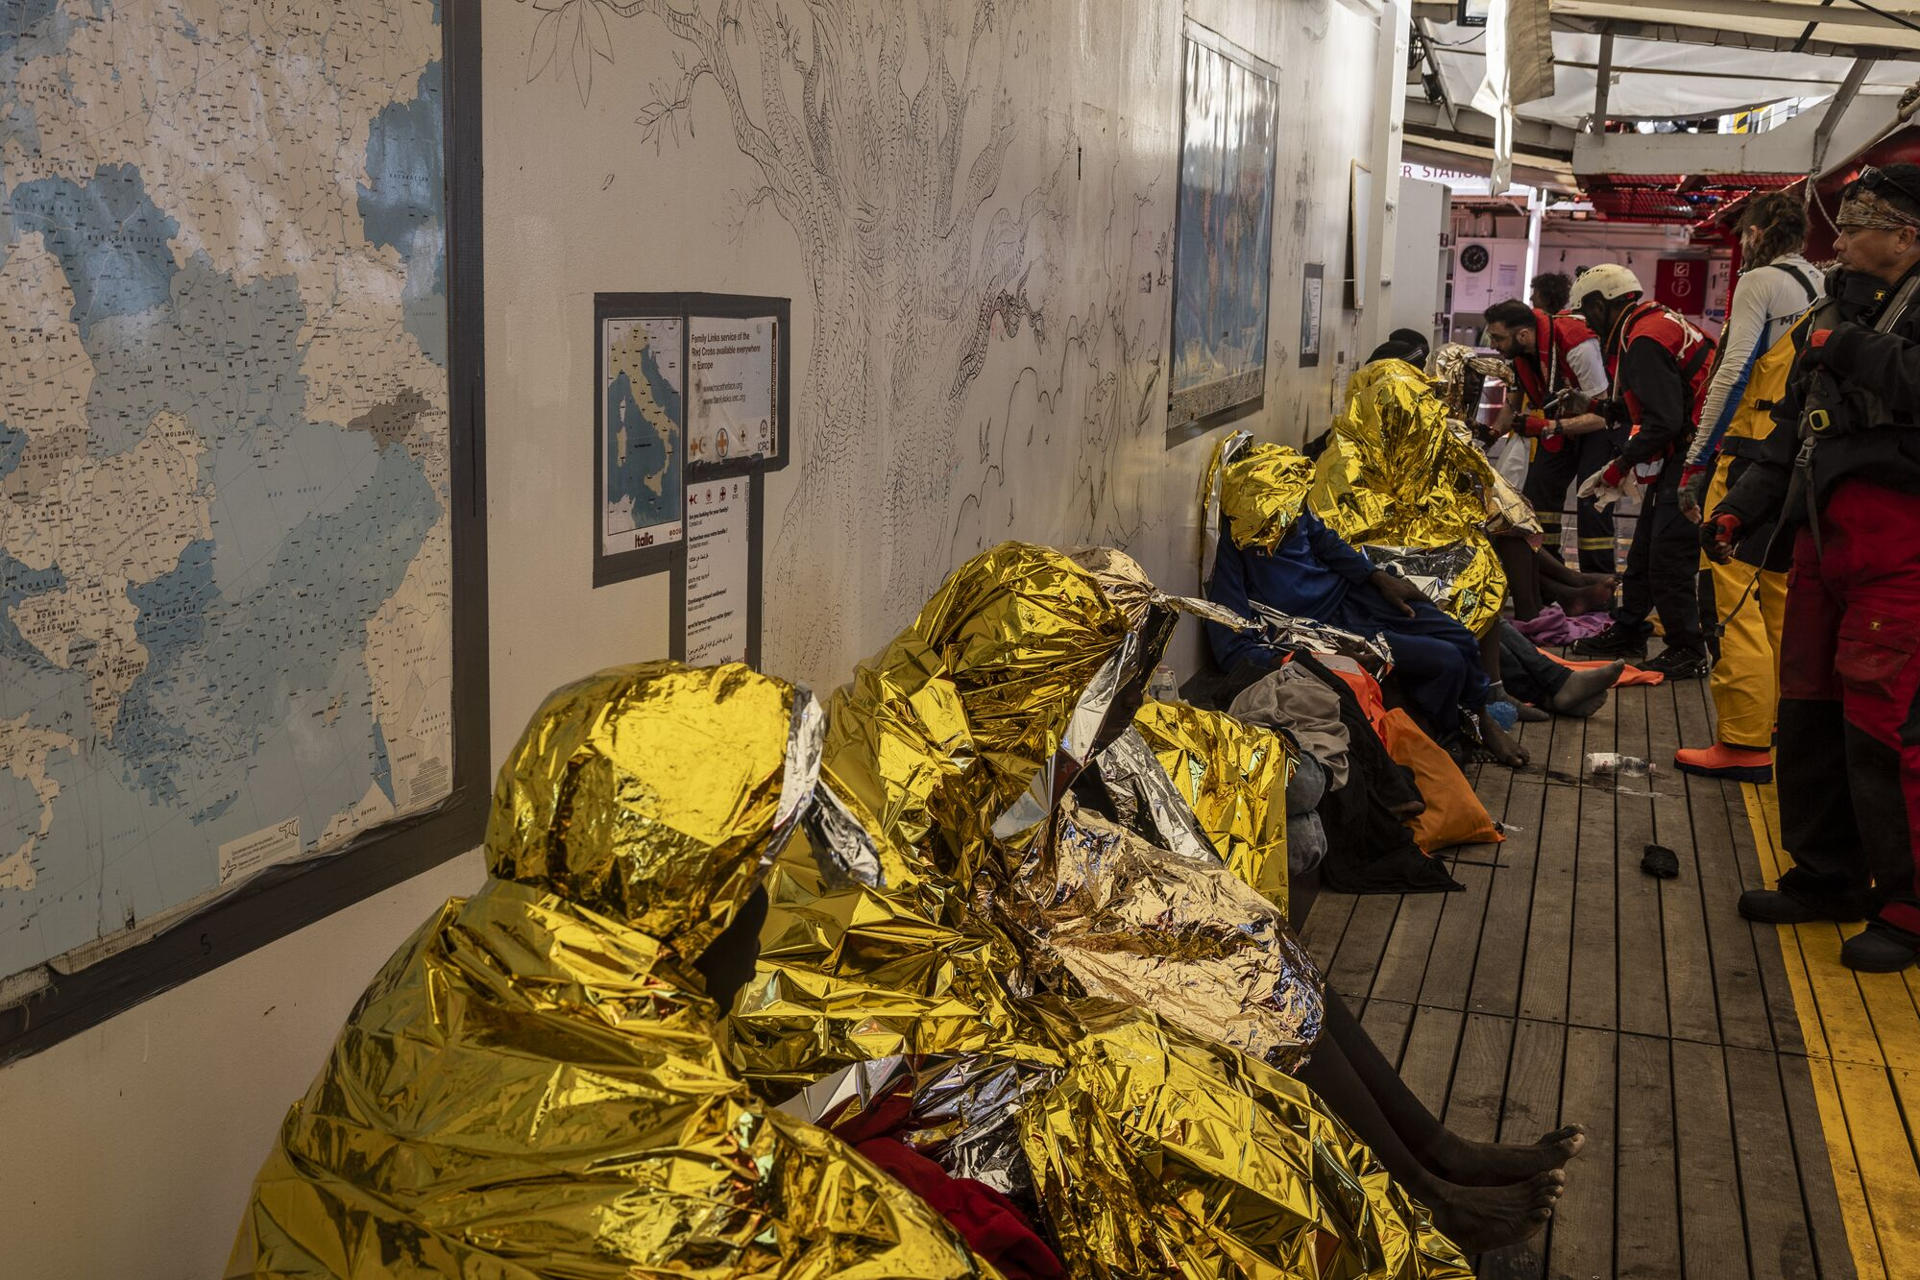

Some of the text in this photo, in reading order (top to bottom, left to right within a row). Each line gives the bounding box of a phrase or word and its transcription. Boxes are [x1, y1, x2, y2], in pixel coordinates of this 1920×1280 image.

[692, 333, 706, 344] Family
[707, 332, 720, 343] Links
[720, 332, 737, 342] service
[702, 346, 716, 356] Cross
[717, 345, 736, 355] available
[736, 345, 760, 355] everywhere
[698, 361, 714, 370] Europe
[635, 532, 654, 548] Italia
